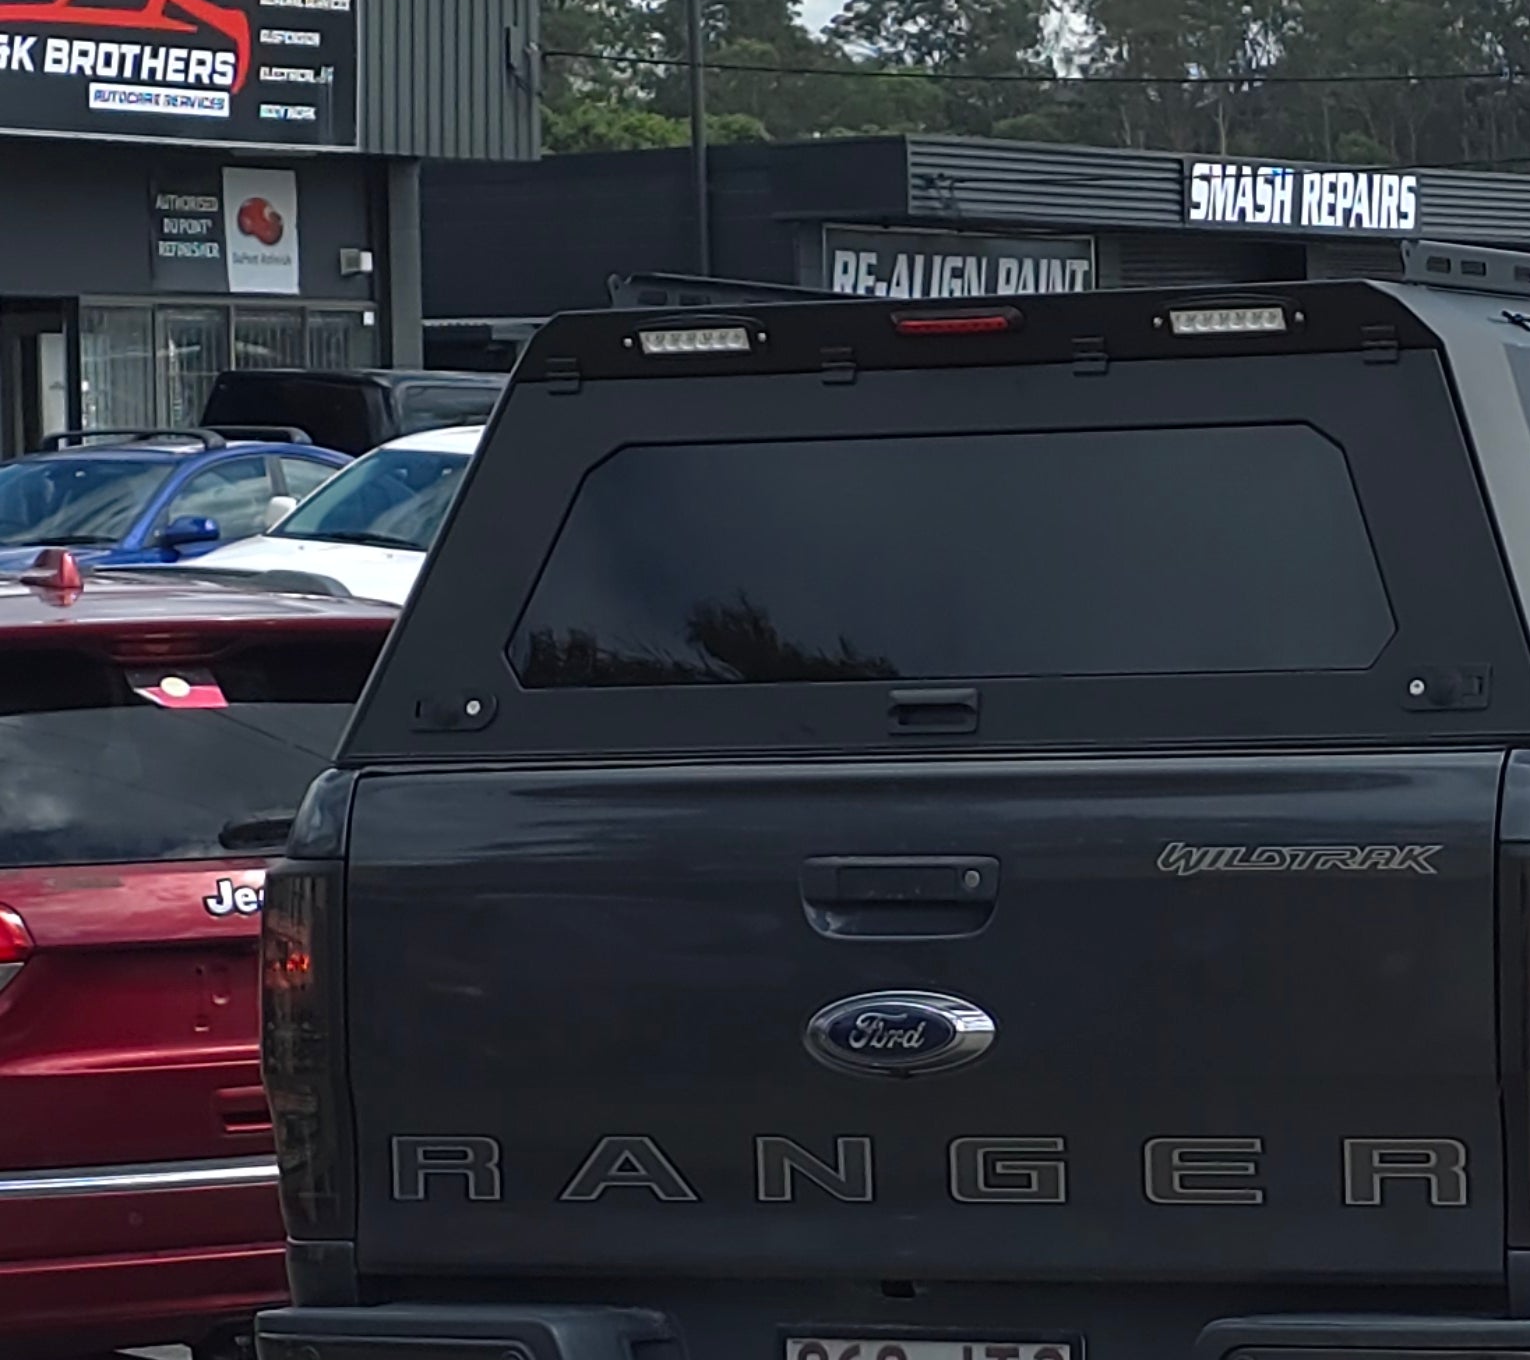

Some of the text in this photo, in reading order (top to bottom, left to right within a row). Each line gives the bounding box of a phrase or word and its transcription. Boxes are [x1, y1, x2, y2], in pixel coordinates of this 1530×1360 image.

[44, 37, 236, 86] BROTHERS
[93, 88, 226, 111] AUTOCARE SERVICES
[1189, 162, 1418, 230] SMASH REPAIRS
[996, 257, 1090, 296] PAINT
[1156, 842, 1444, 876] WILDTRAK
[202, 877, 265, 917] Je
[849, 1011, 928, 1049] Ford
[388, 1134, 1468, 1207] RANGER
